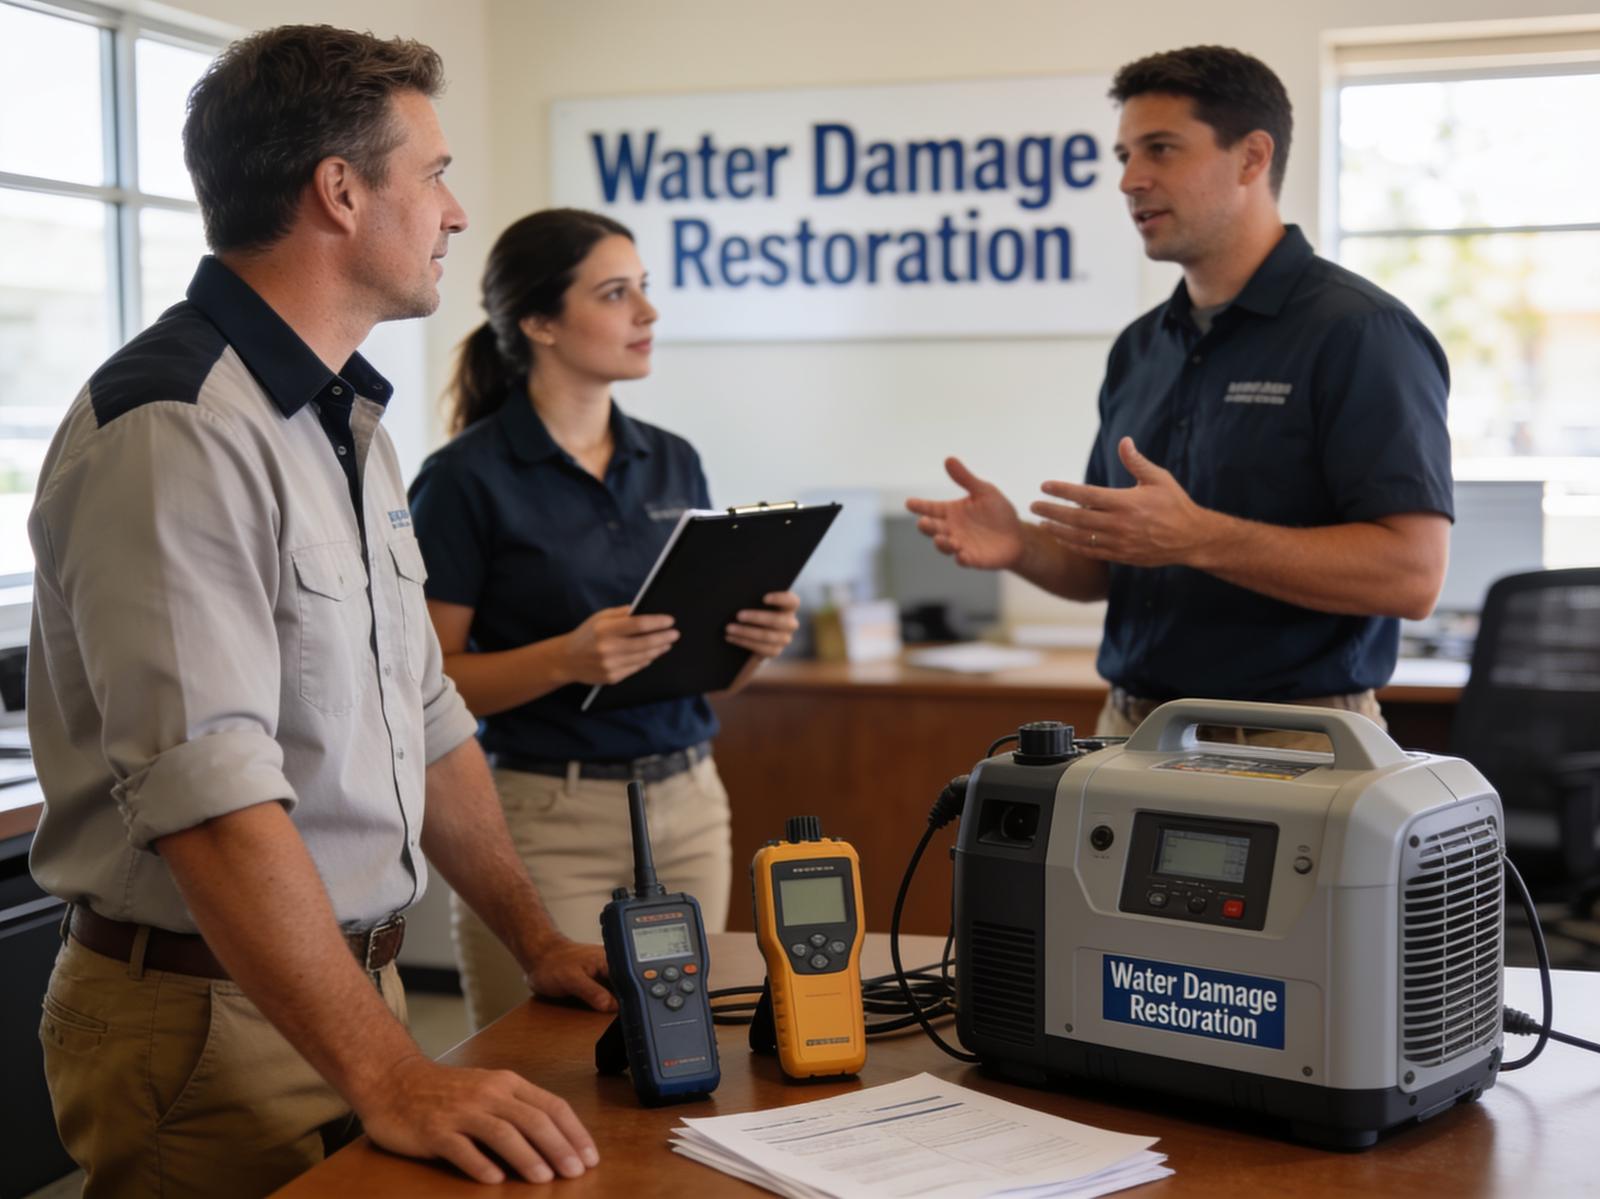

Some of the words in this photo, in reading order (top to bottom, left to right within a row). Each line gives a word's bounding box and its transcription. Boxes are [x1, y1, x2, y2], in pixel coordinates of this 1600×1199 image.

[591, 132, 788, 203] Water
[813, 123, 1098, 209] Damage
[672, 211, 1072, 288] Restoration
[1110, 961, 1177, 995] Water
[1184, 972, 1277, 1015] Damage
[1130, 994, 1257, 1039] Restoration
